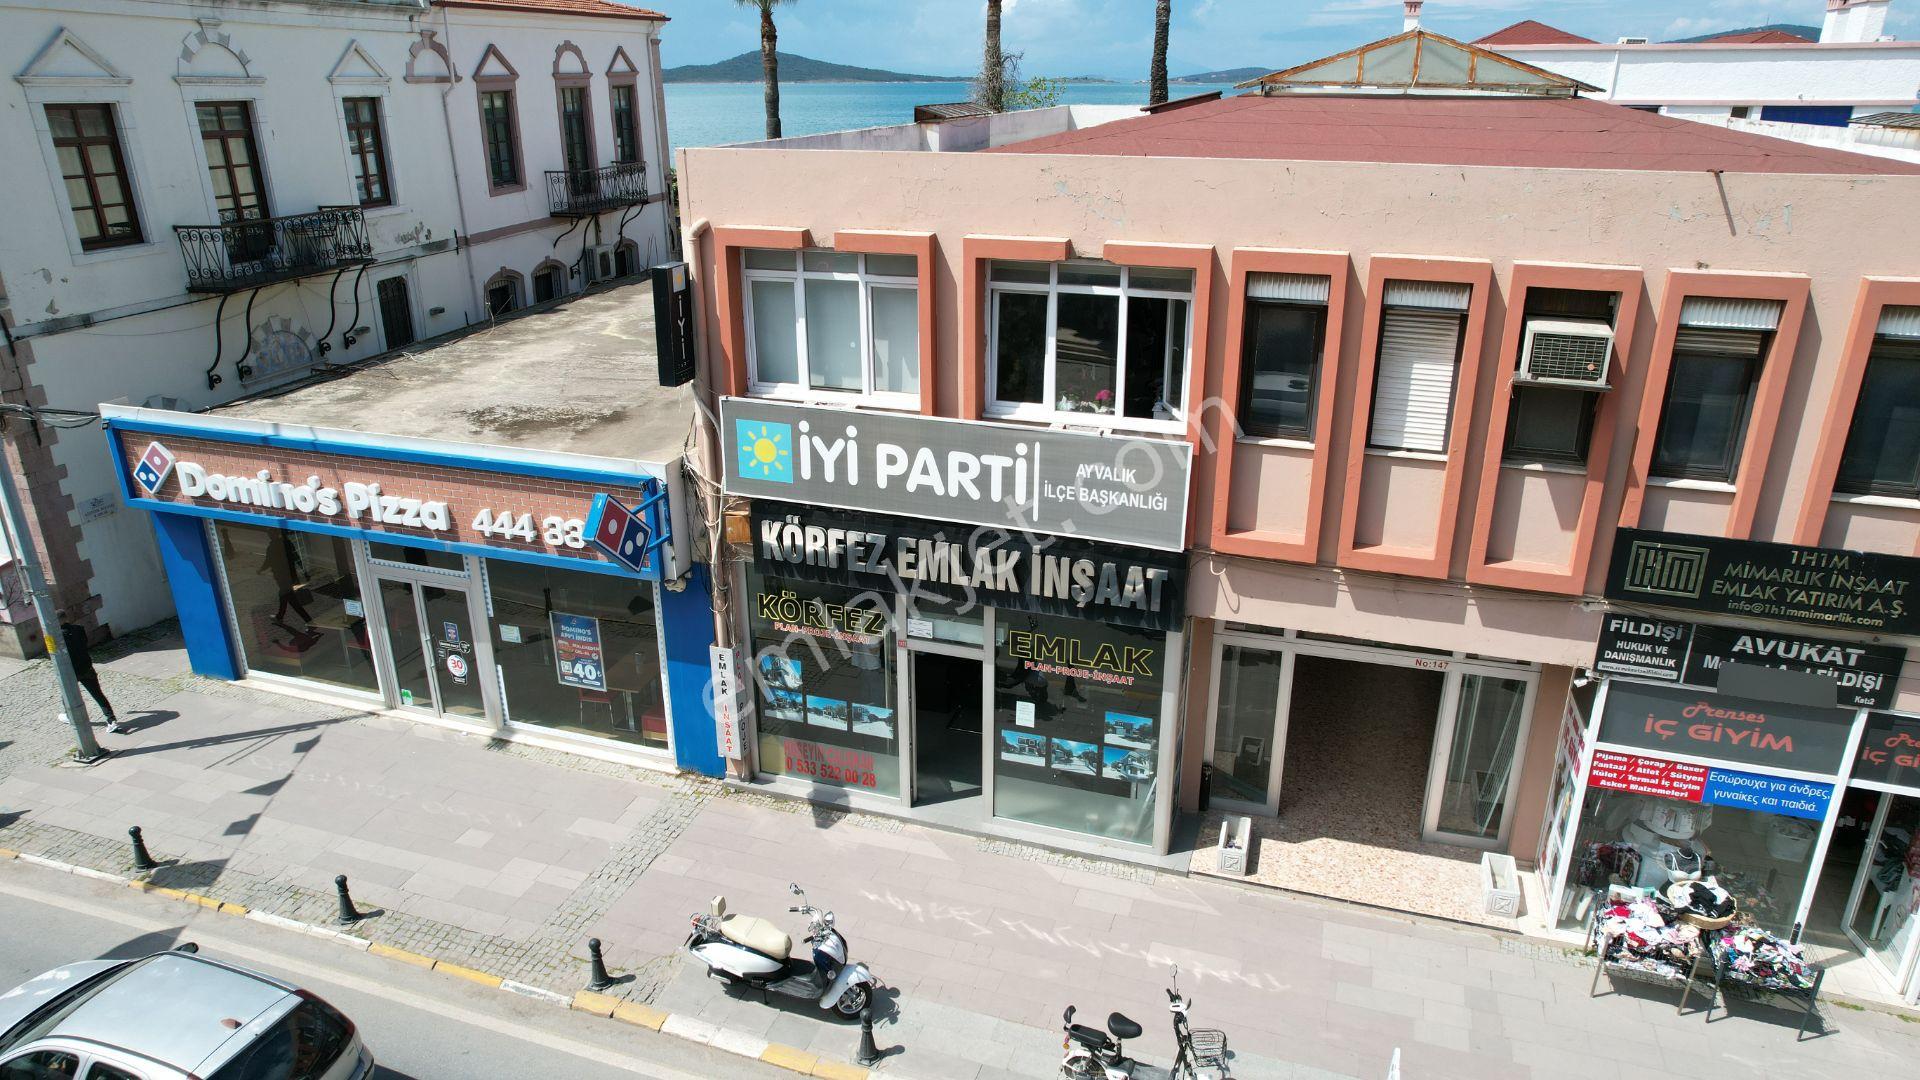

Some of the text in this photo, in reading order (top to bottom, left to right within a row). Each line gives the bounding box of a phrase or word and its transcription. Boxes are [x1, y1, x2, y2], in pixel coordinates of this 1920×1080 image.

[798, 420, 1026, 505] İYİ PARTİ
[1076, 463, 1136, 484] AYVALIK
[175, 461, 342, 516] Domino's
[344, 482, 450, 531] Pizza
[472, 508, 537, 542] 444
[1044, 480, 1167, 511] İLÇE BAŞKANLIĞI
[761, 514, 1168, 612] KÖRFEZ EMLAK İNŞAAT
[1712, 579, 1778, 600] EMLAK
[1724, 561, 1909, 595] MİMARLIK İNŞAAT
[757, 590, 884, 636] KÖRFEZ
[1609, 618, 1684, 642] FİLDİŞİ
[1009, 630, 1154, 676] EMLAK
[1604, 650, 1676, 668] DANIŞMANLIK
[1616, 640, 1669, 655] HUKUK VE
[1732, 635, 1866, 667] AVUKAT
[1415, 658, 1449, 670] No:147
[1682, 701, 1766, 723] Prenses
[1644, 714, 1793, 752] İÇ GİYİM
[785, 756, 793, 772] 0
[1862, 746, 1888, 765] İÇ
